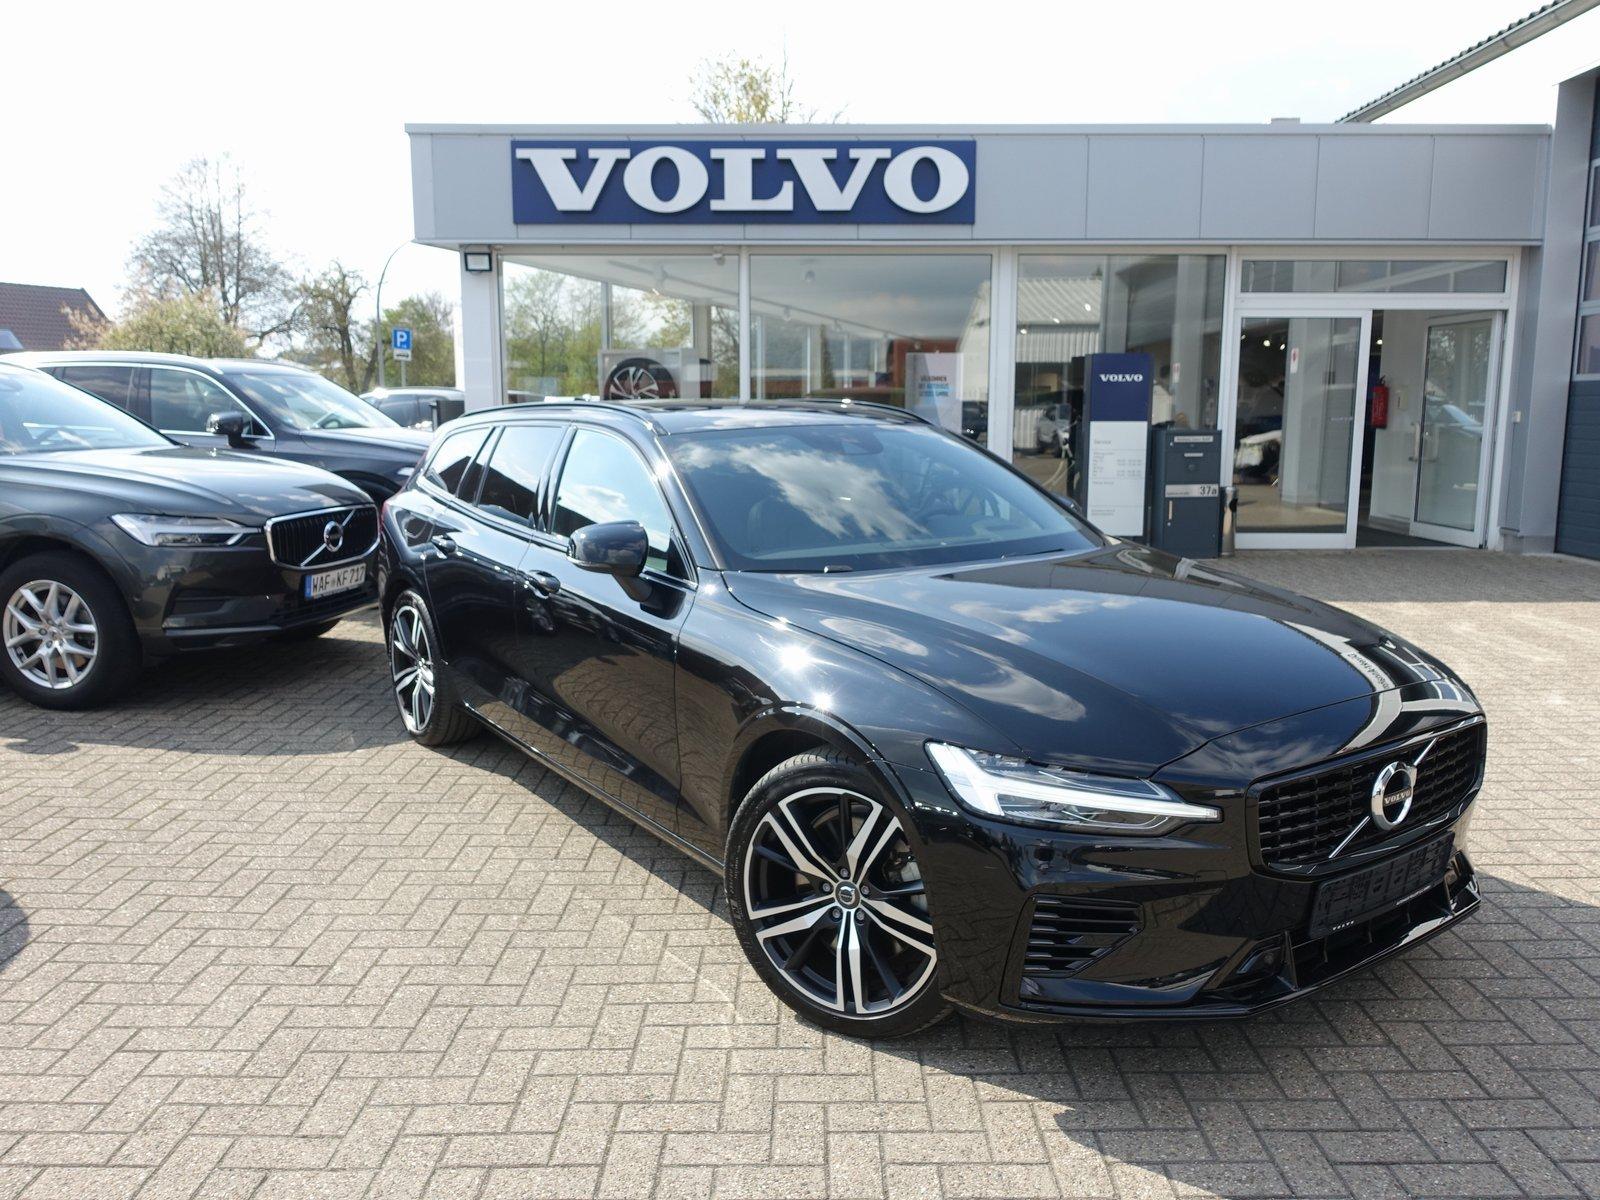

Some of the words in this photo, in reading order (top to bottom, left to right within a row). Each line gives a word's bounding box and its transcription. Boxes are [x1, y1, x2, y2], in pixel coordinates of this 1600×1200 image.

[515, 146, 970, 214] VOLVO
[396, 331, 408, 348] P
[1099, 373, 1143, 382] VOLVO
[1200, 485, 1217, 495] 37a
[312, 574, 331, 593] WAF
[1384, 789, 1411, 804] VOLVO
